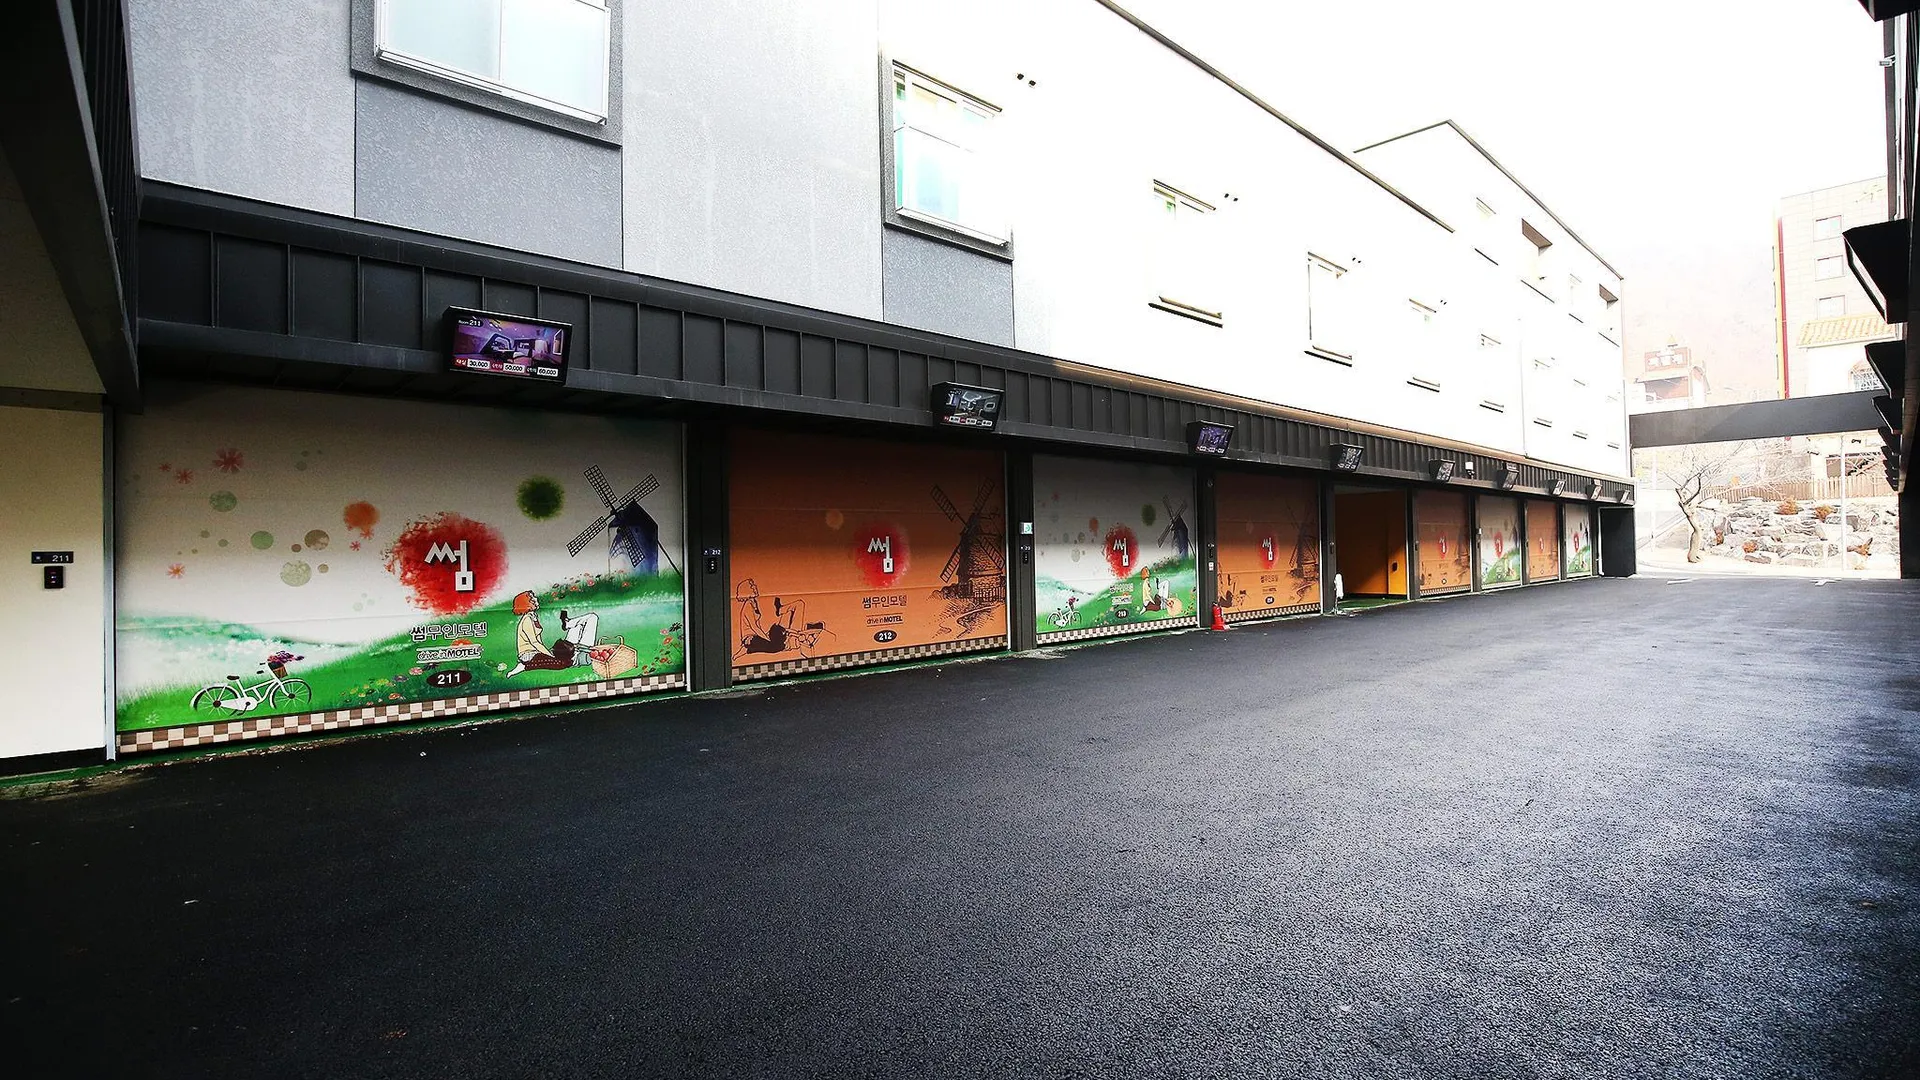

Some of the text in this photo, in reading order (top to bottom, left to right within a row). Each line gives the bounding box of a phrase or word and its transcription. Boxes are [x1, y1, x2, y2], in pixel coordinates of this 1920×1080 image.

[469, 319, 481, 327] 211
[52, 554, 70, 562] 211
[424, 540, 474, 591] 썸
[862, 595, 908, 609] 썸무인모텔
[411, 622, 488, 641] 썸무인모텔
[878, 632, 893, 641] 212
[447, 646, 480, 659] MOTEL
[437, 672, 461, 685] 211
